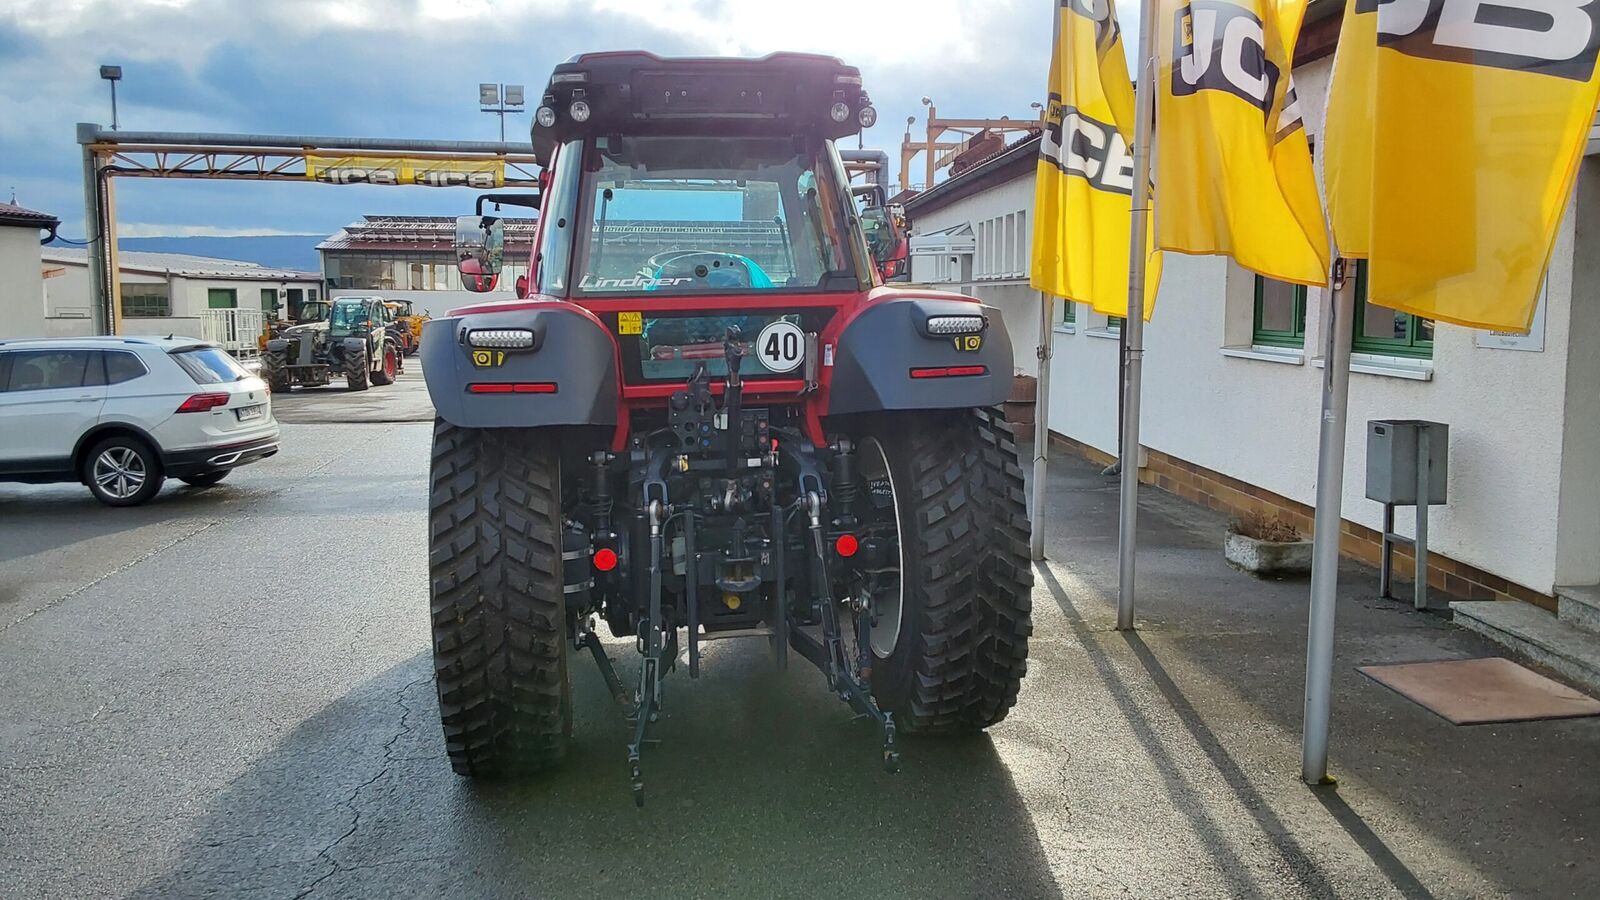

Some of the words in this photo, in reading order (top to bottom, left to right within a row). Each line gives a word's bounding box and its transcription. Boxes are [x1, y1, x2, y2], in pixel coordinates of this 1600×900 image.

[317, 169, 397, 185] JCB
[417, 171, 495, 187] JCB
[578, 273, 693, 288] Lindner
[765, 332, 798, 361] 40
